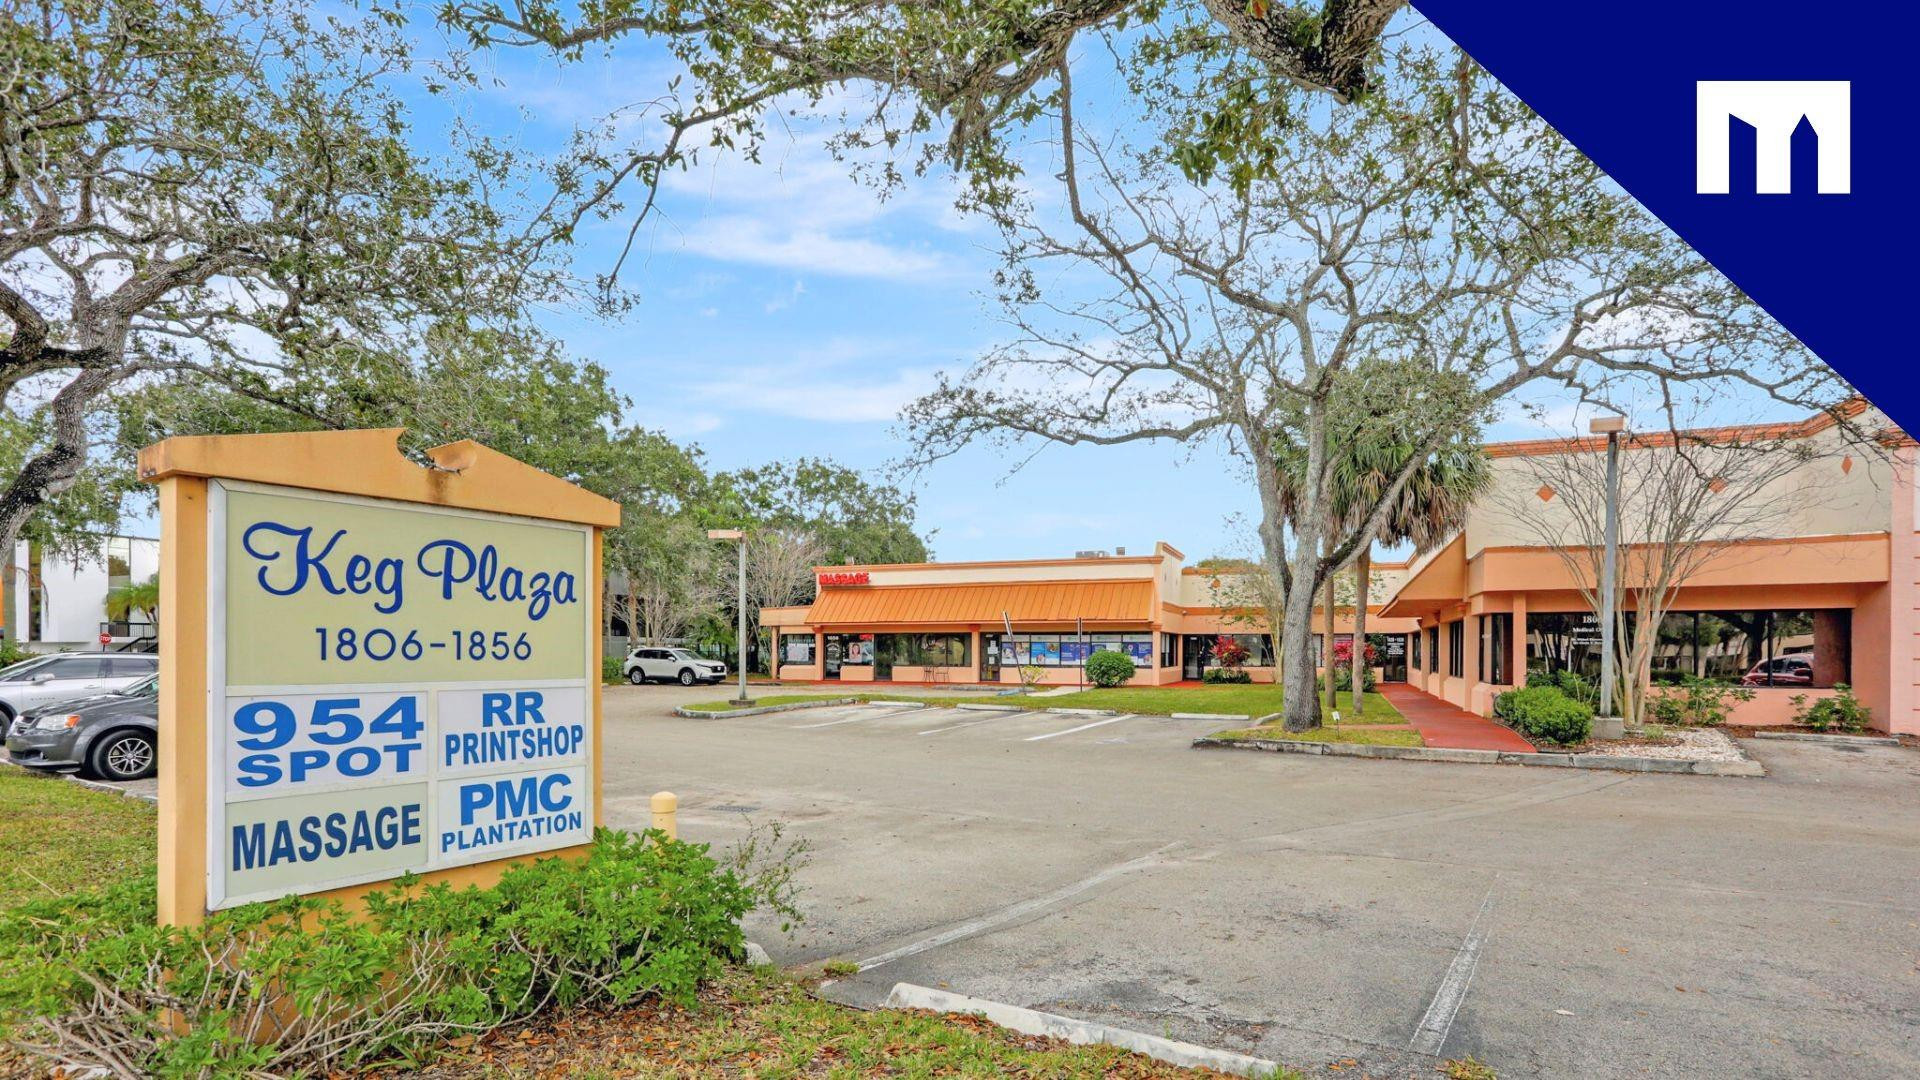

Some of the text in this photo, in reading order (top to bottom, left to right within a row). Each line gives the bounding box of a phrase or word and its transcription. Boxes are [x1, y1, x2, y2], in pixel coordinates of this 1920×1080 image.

[243, 522, 577, 621] Keg Plaza
[316, 627, 533, 661] 1806-1856
[233, 696, 425, 752] 954
[482, 691, 545, 727] RR
[237, 742, 423, 788] SPOT
[445, 724, 584, 767] PRINTSHOP
[460, 774, 573, 826] PMC
[233, 803, 421, 872] MASSAGE
[442, 811, 582, 853] PLANTATION
